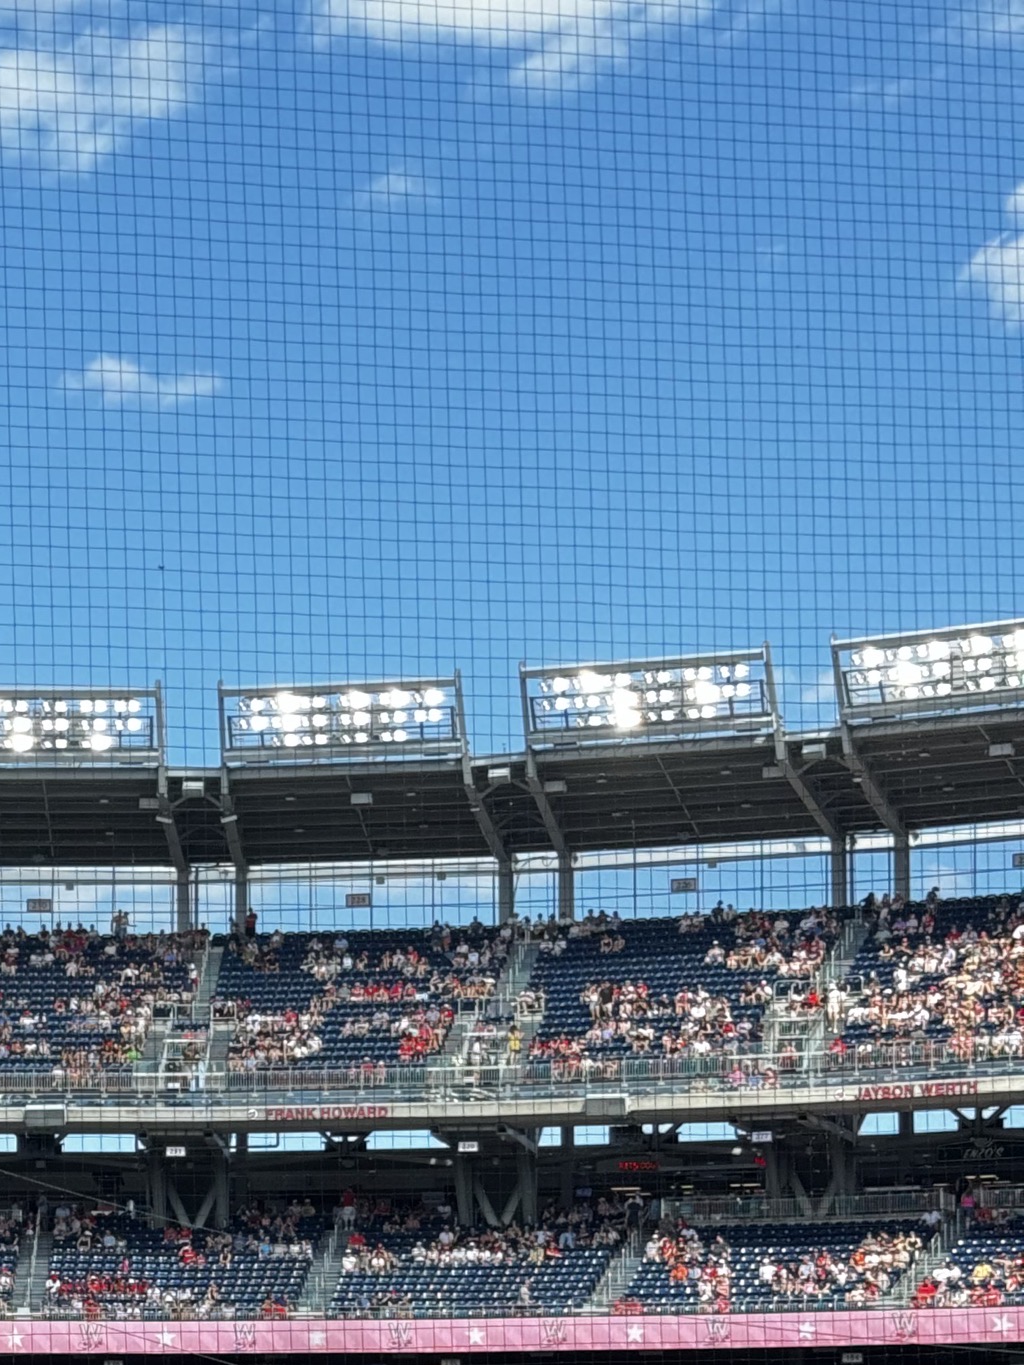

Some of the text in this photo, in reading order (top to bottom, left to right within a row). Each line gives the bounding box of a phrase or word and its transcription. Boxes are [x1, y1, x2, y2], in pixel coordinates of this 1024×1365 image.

[854, 1080, 978, 1100] JAYSON WERTH
[266, 1106, 388, 1120] FRANK HOWARD
